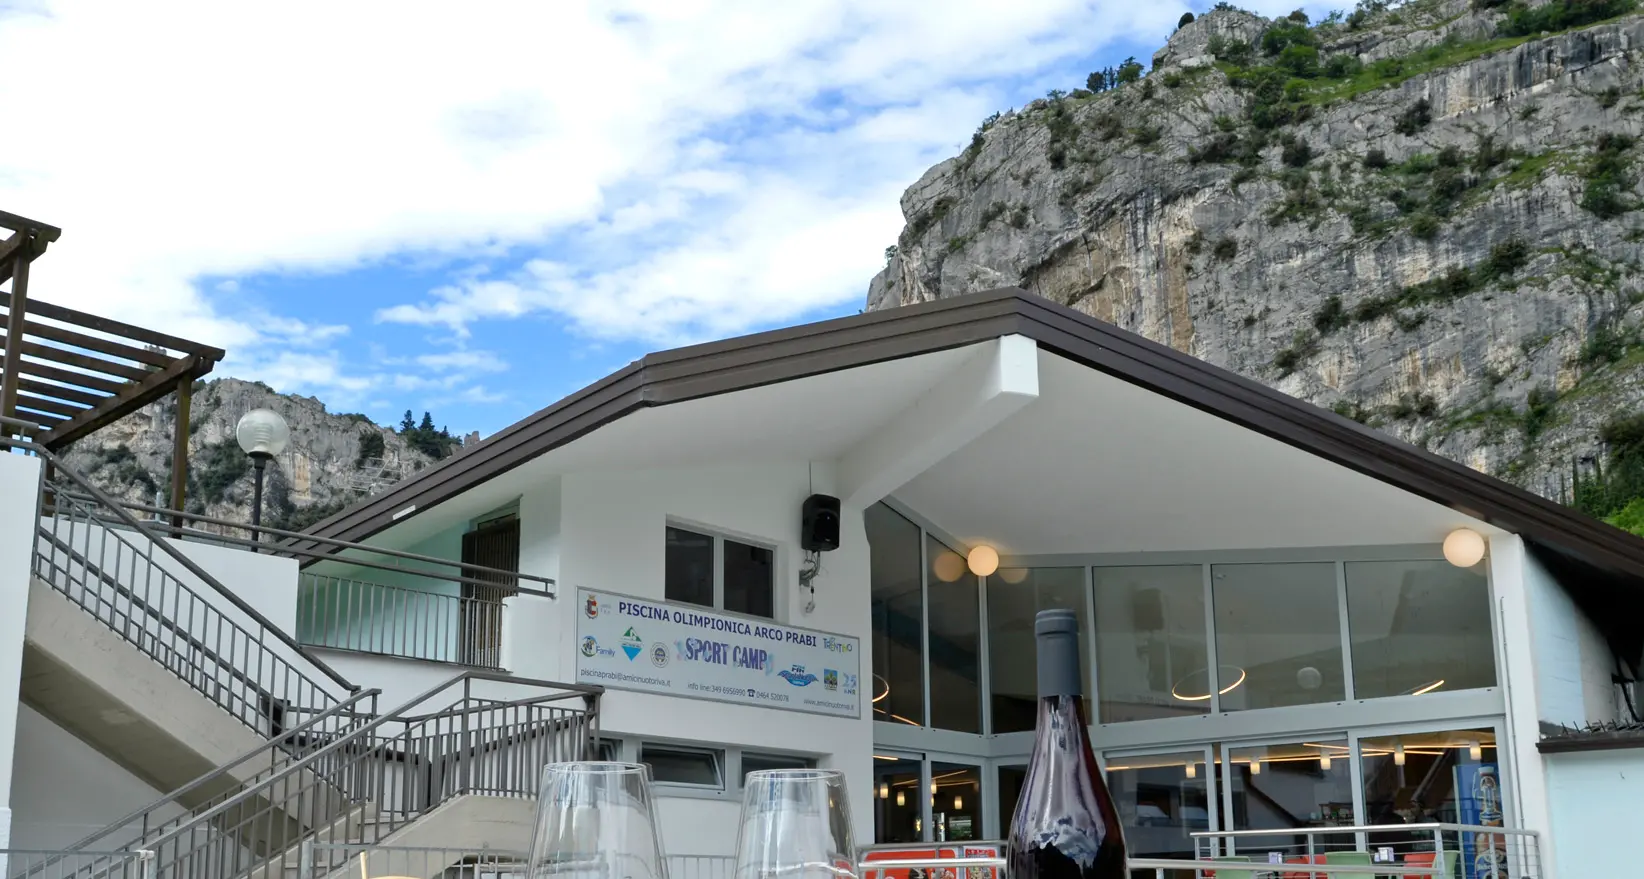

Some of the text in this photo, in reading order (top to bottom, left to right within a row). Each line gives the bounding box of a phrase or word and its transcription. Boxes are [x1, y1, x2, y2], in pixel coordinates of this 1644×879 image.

[619, 602, 670, 622] PISCINA
[673, 611, 751, 636] OLIMPIONICA
[754, 626, 783, 641] ARCO
[786, 631, 817, 647] PRABI
[596, 645, 615, 657] Family
[685, 637, 728, 665] SPORT
[733, 645, 767, 670] CAMP
[687, 682, 699, 690] info
